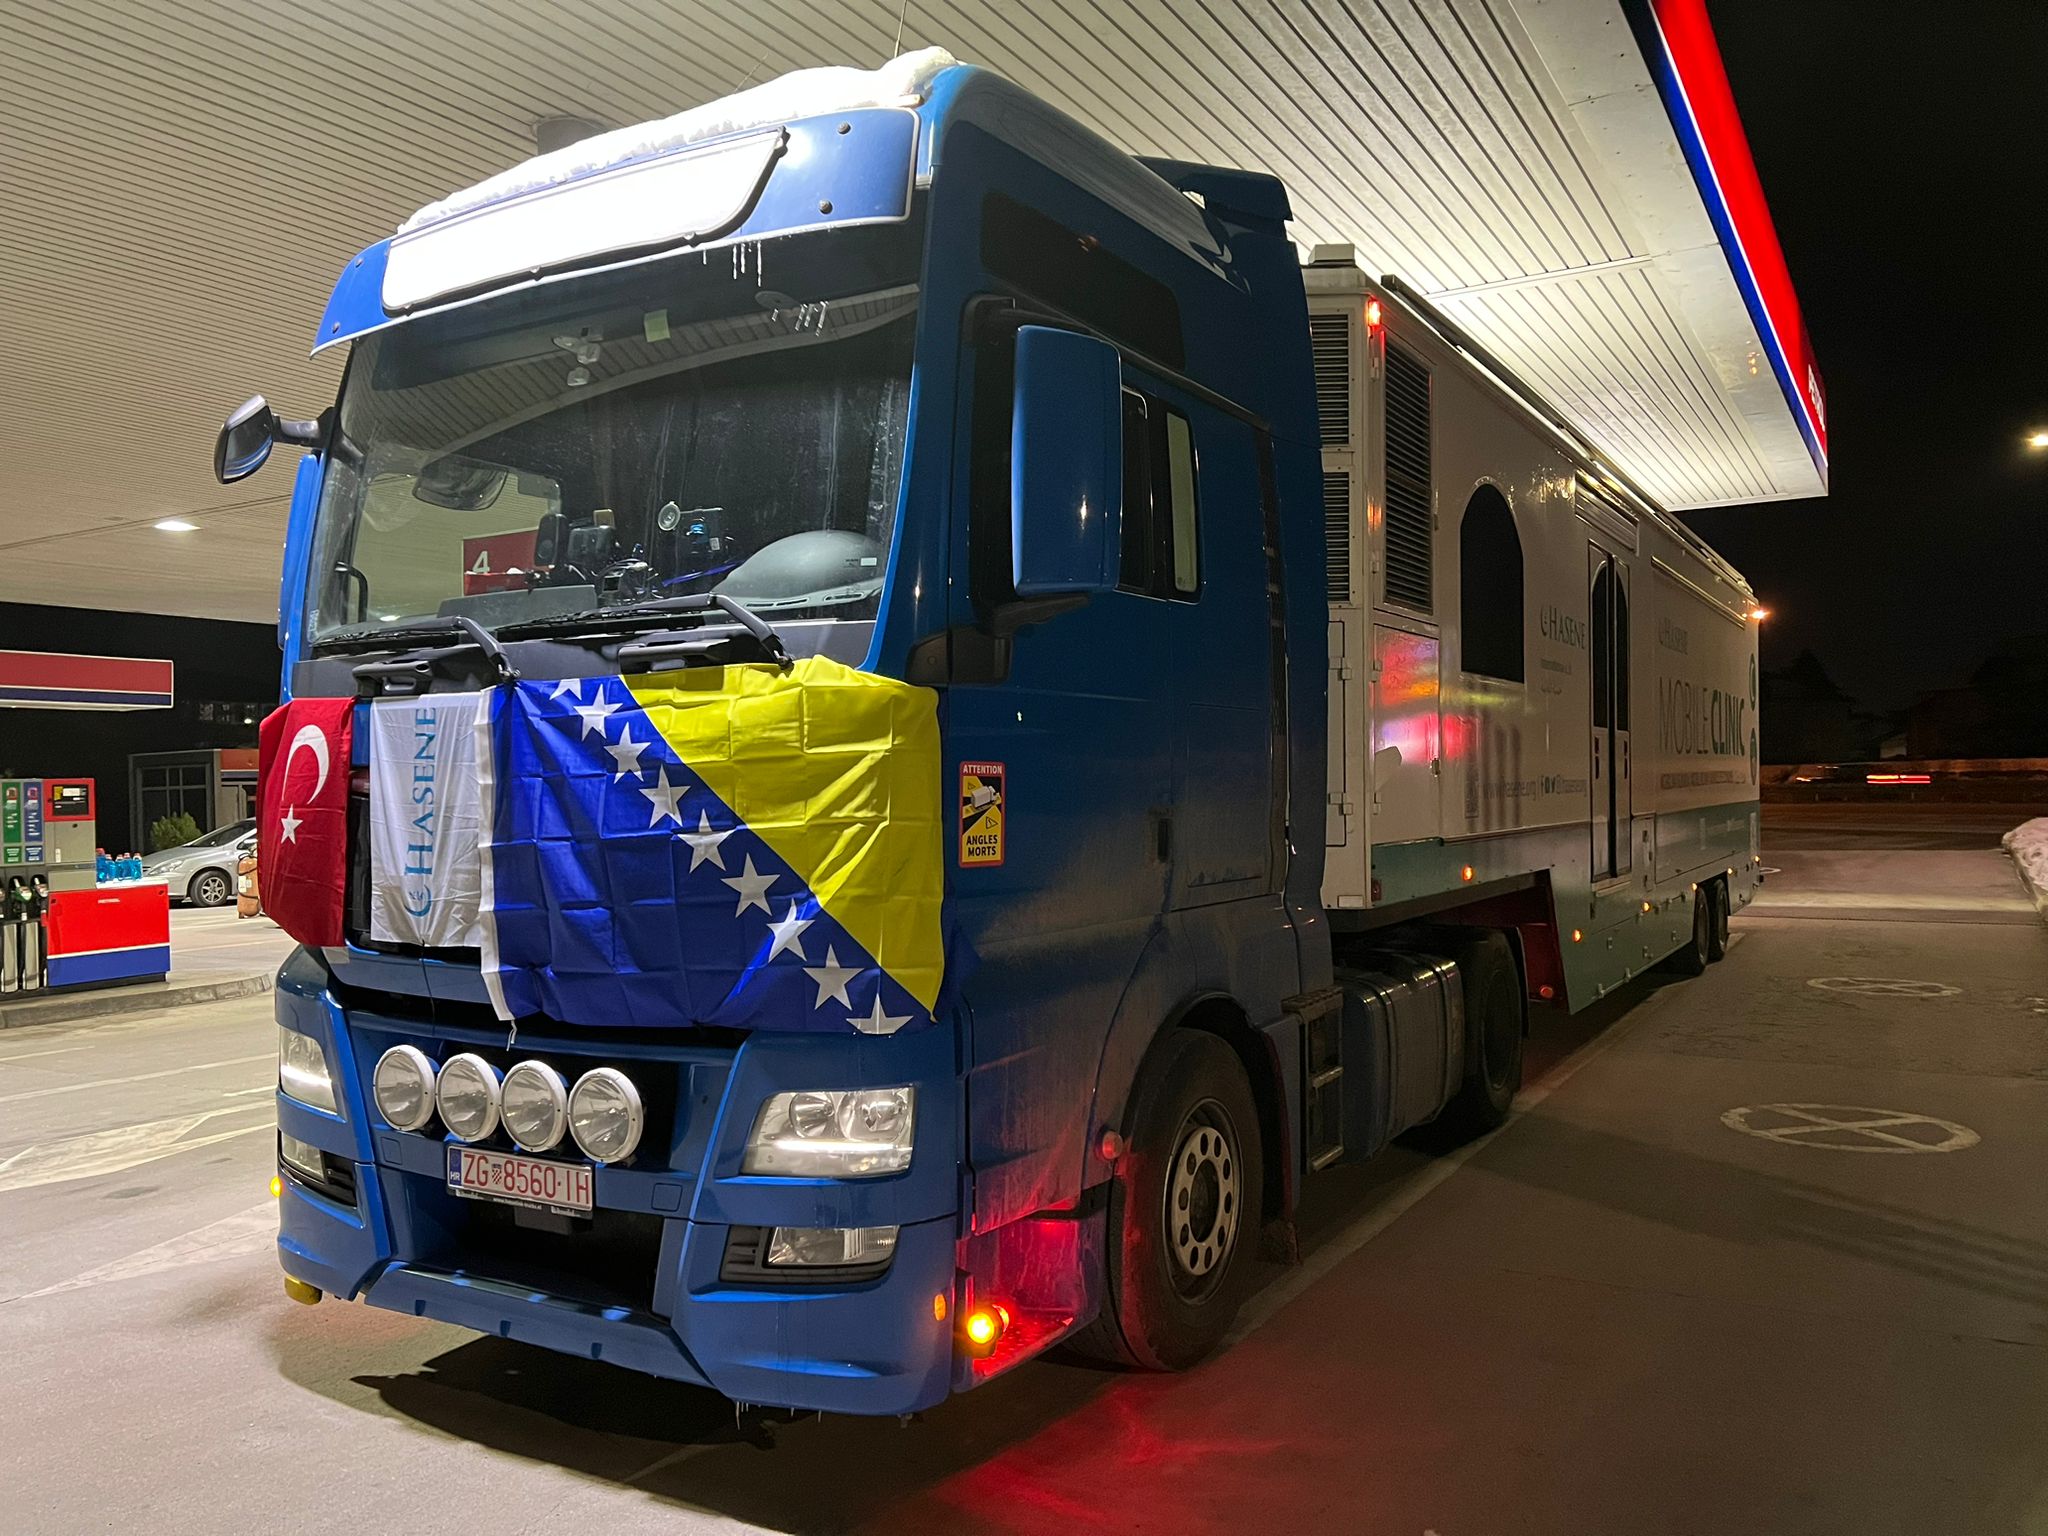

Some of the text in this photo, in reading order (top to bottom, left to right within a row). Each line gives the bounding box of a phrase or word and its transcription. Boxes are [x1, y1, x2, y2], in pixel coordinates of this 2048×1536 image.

[472, 550, 490, 574] 4
[1659, 675, 1745, 757] MOBILE CLINIC
[962, 764, 1003, 775] ATTENTION
[404, 707, 437, 876] HASENE
[966, 834, 998, 846] ANGLES
[967, 845, 997, 858] MORTS
[450, 1170, 461, 1182] HR
[463, 1153, 489, 1187] ZG
